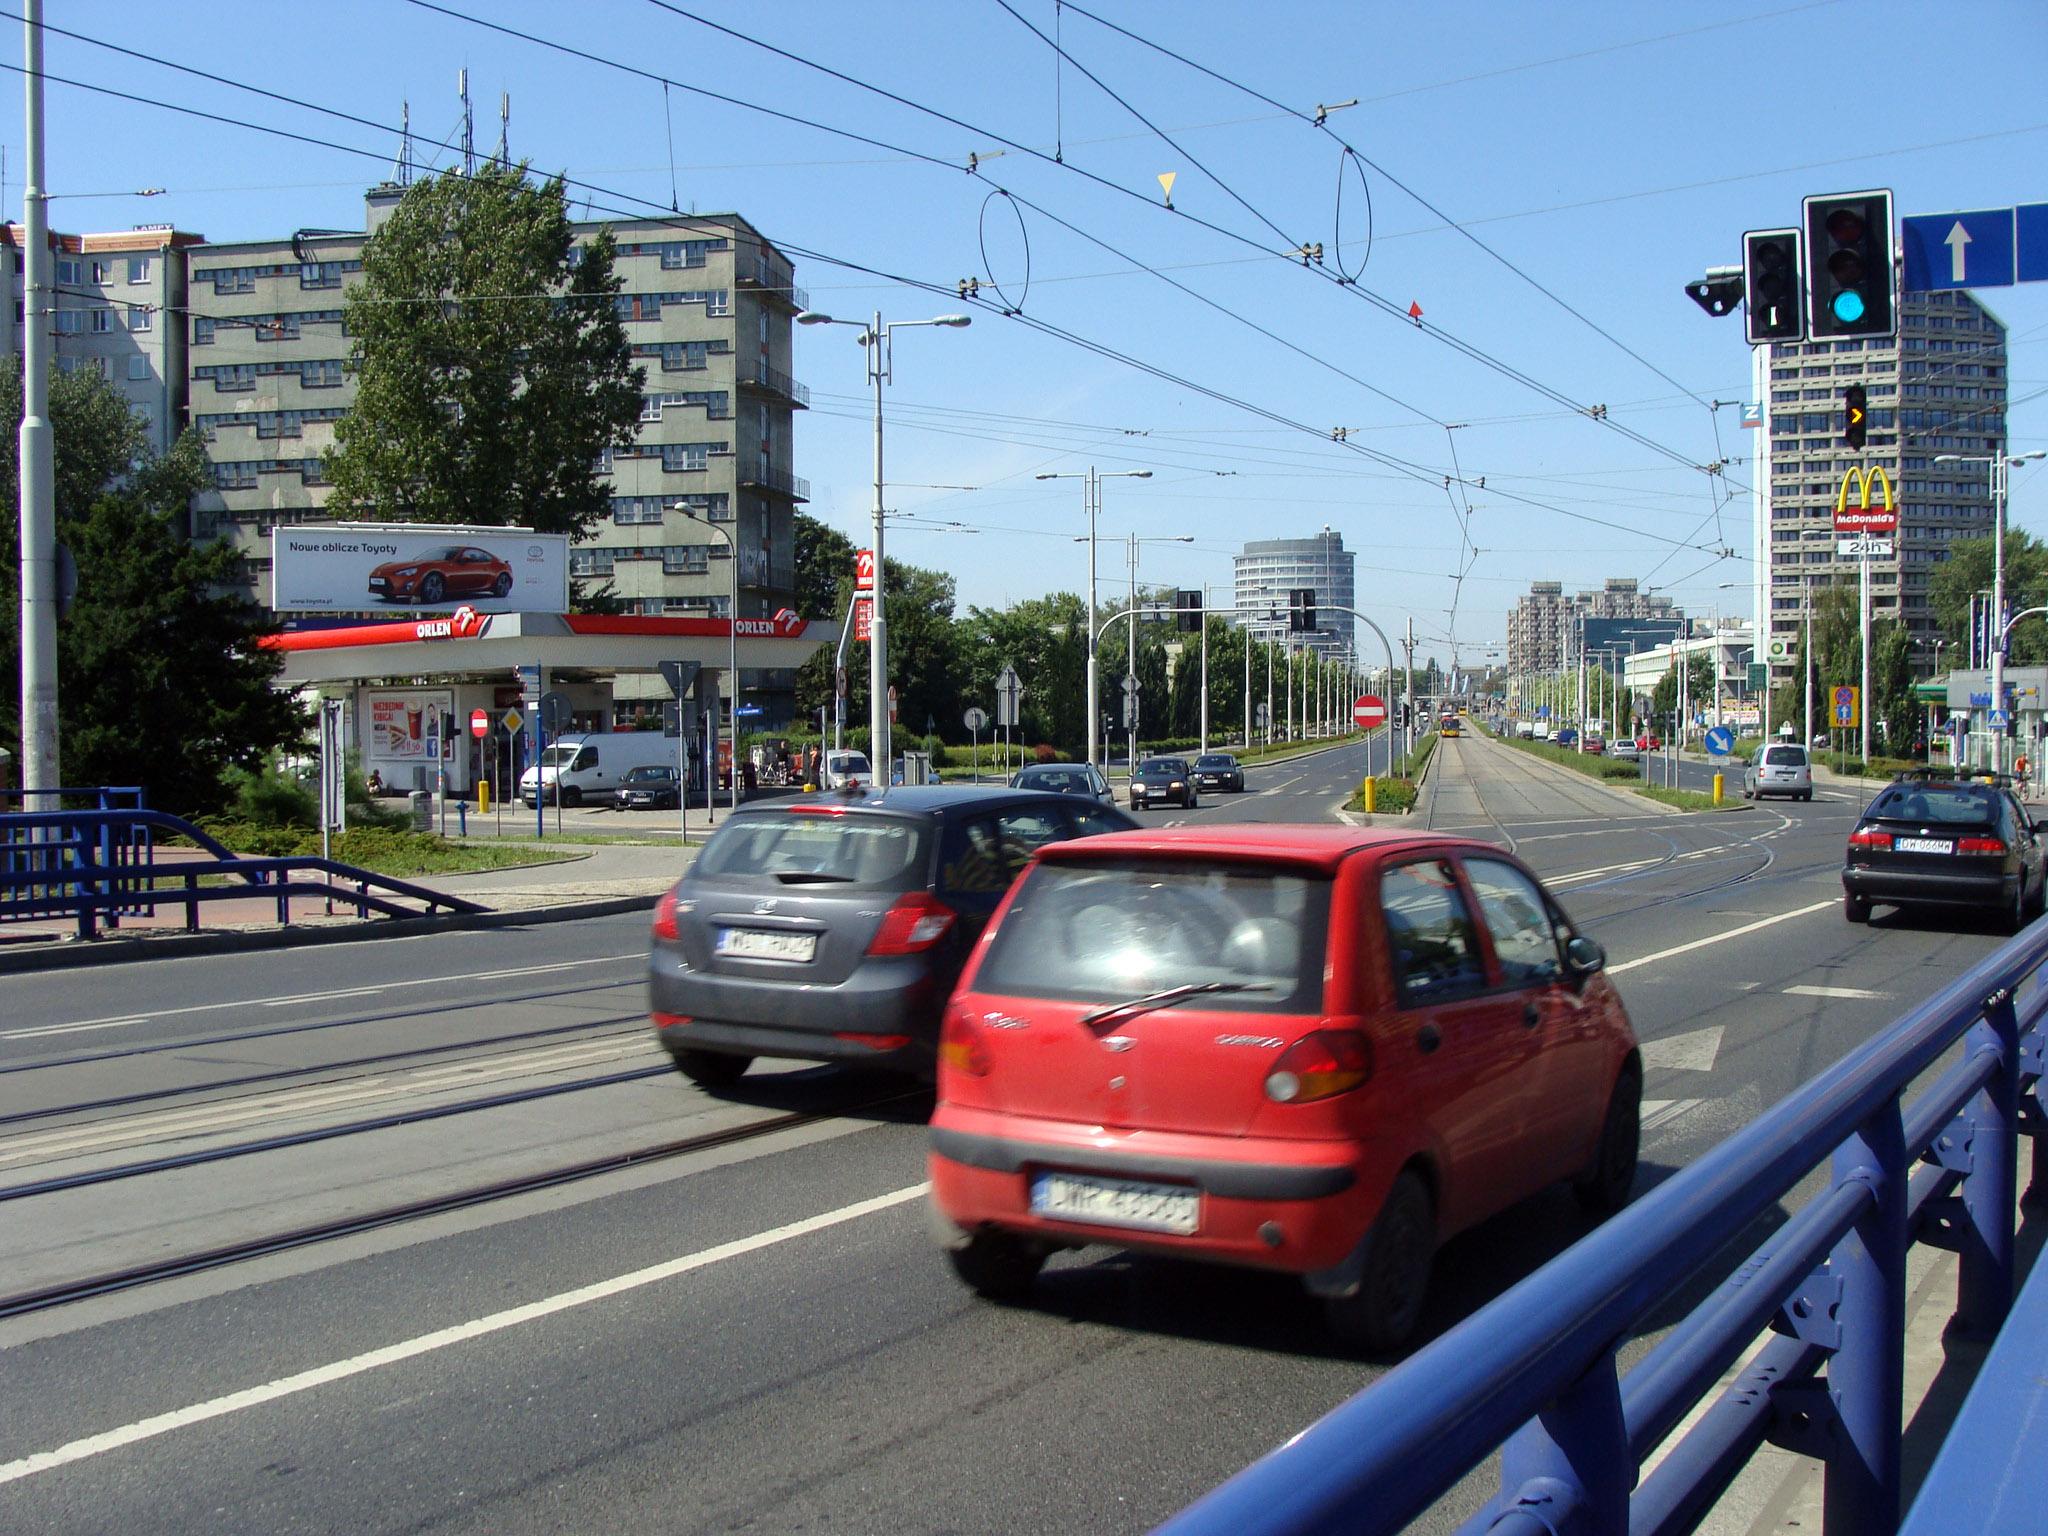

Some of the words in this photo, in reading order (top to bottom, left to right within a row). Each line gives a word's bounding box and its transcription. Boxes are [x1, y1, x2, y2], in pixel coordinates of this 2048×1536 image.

[1836, 514, 1895, 524] McDonald's
[289, 542, 320, 552] Nowe
[321, 542, 359, 553] oblicze
[361, 543, 398, 556] Toyoty
[1849, 541, 1881, 553] 24h
[416, 621, 451, 638] ORLEN
[735, 620, 775, 634] ORLEN
